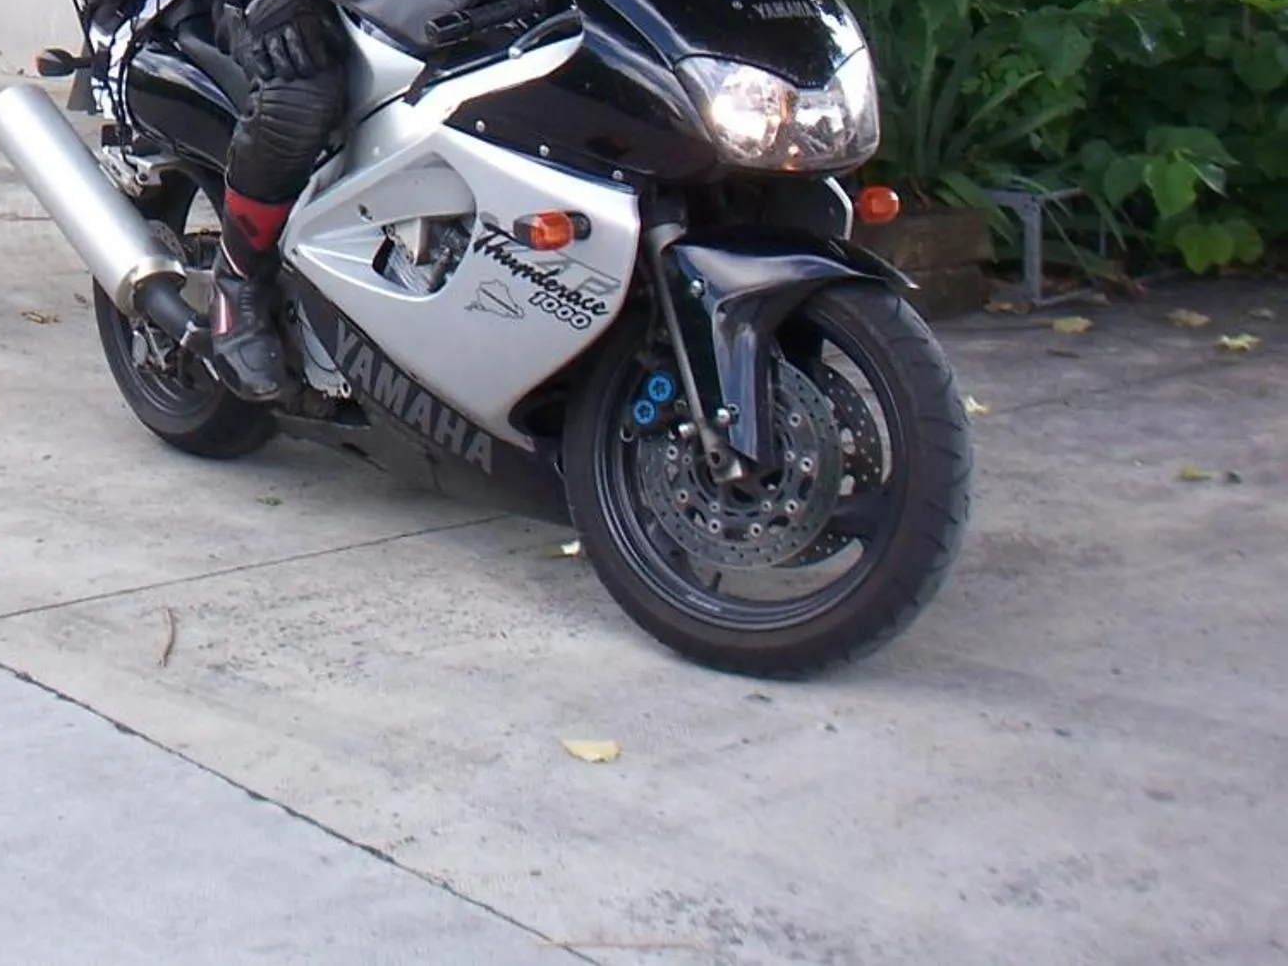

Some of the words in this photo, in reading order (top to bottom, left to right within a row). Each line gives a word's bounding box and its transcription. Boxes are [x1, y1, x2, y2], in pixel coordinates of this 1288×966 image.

[752, 1, 816, 20] YAMAHA
[528, 291, 592, 330] 1000
[334, 317, 493, 475] YAMAHA
